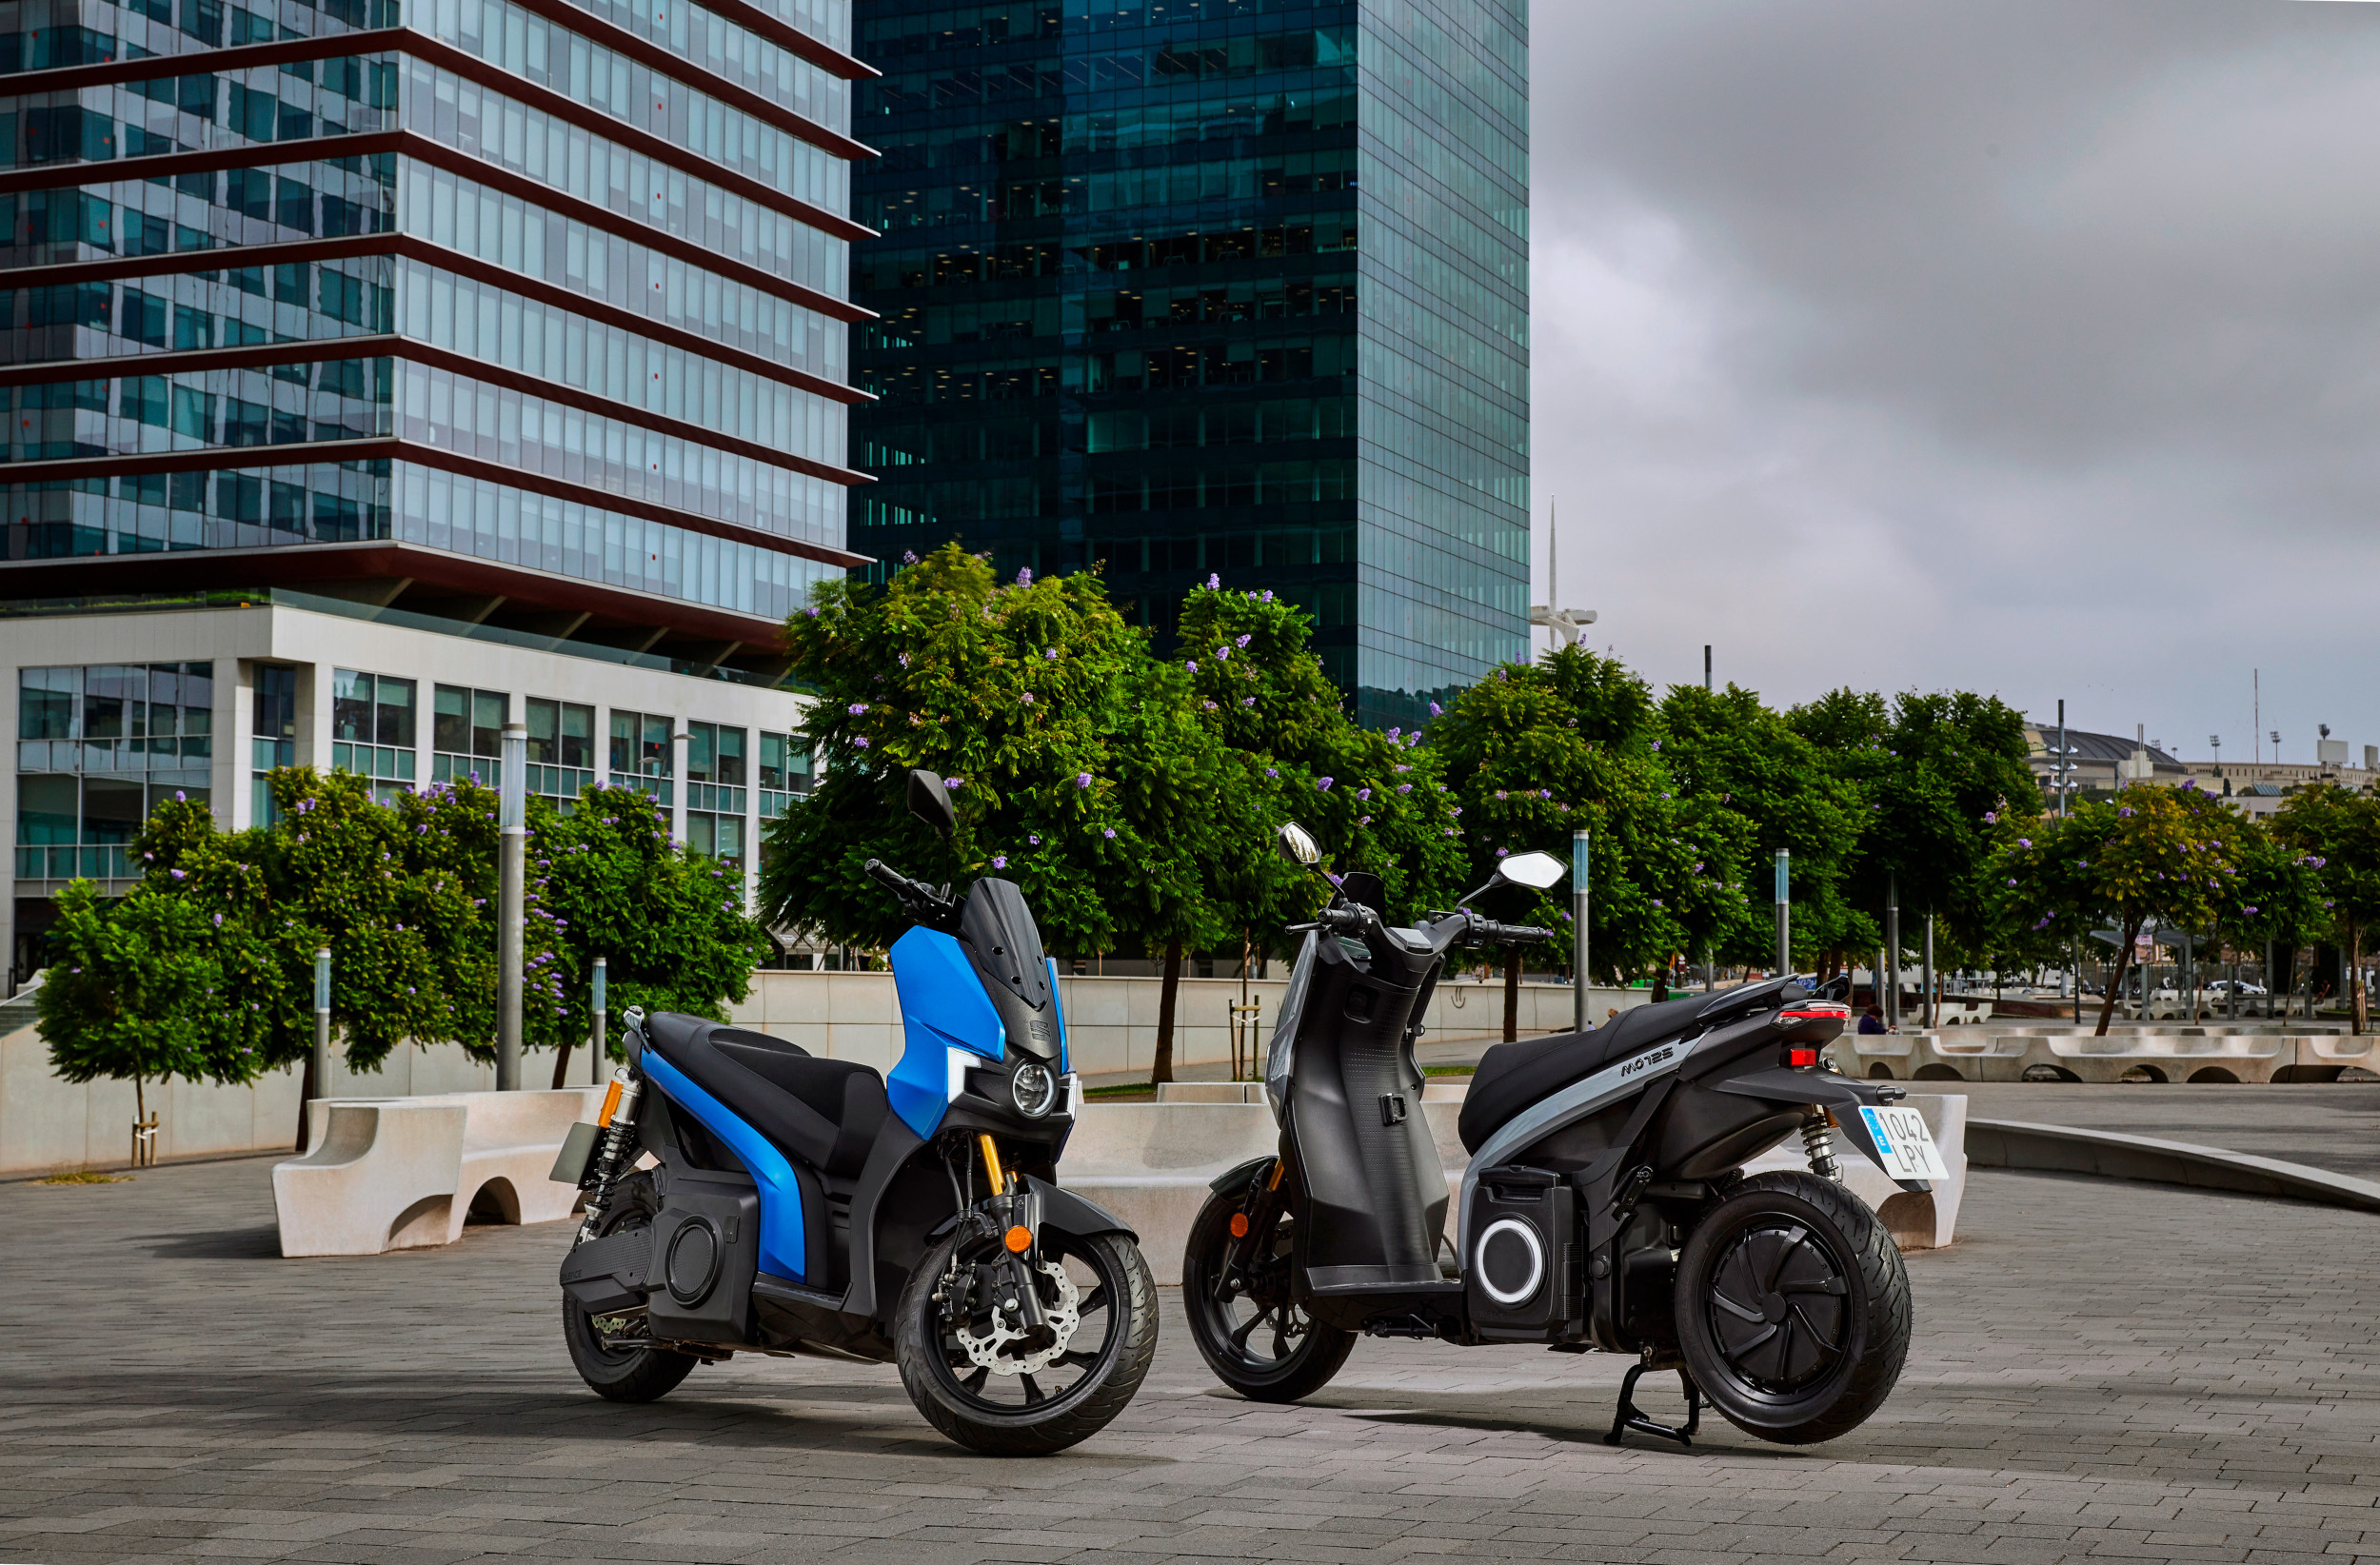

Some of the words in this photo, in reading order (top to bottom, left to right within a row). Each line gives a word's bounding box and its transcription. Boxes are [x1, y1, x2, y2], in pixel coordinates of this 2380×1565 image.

[1877, 1135, 1886, 1146] E
[1879, 1113, 1929, 1141] 1042
[1892, 1145, 1931, 1173] LPY
